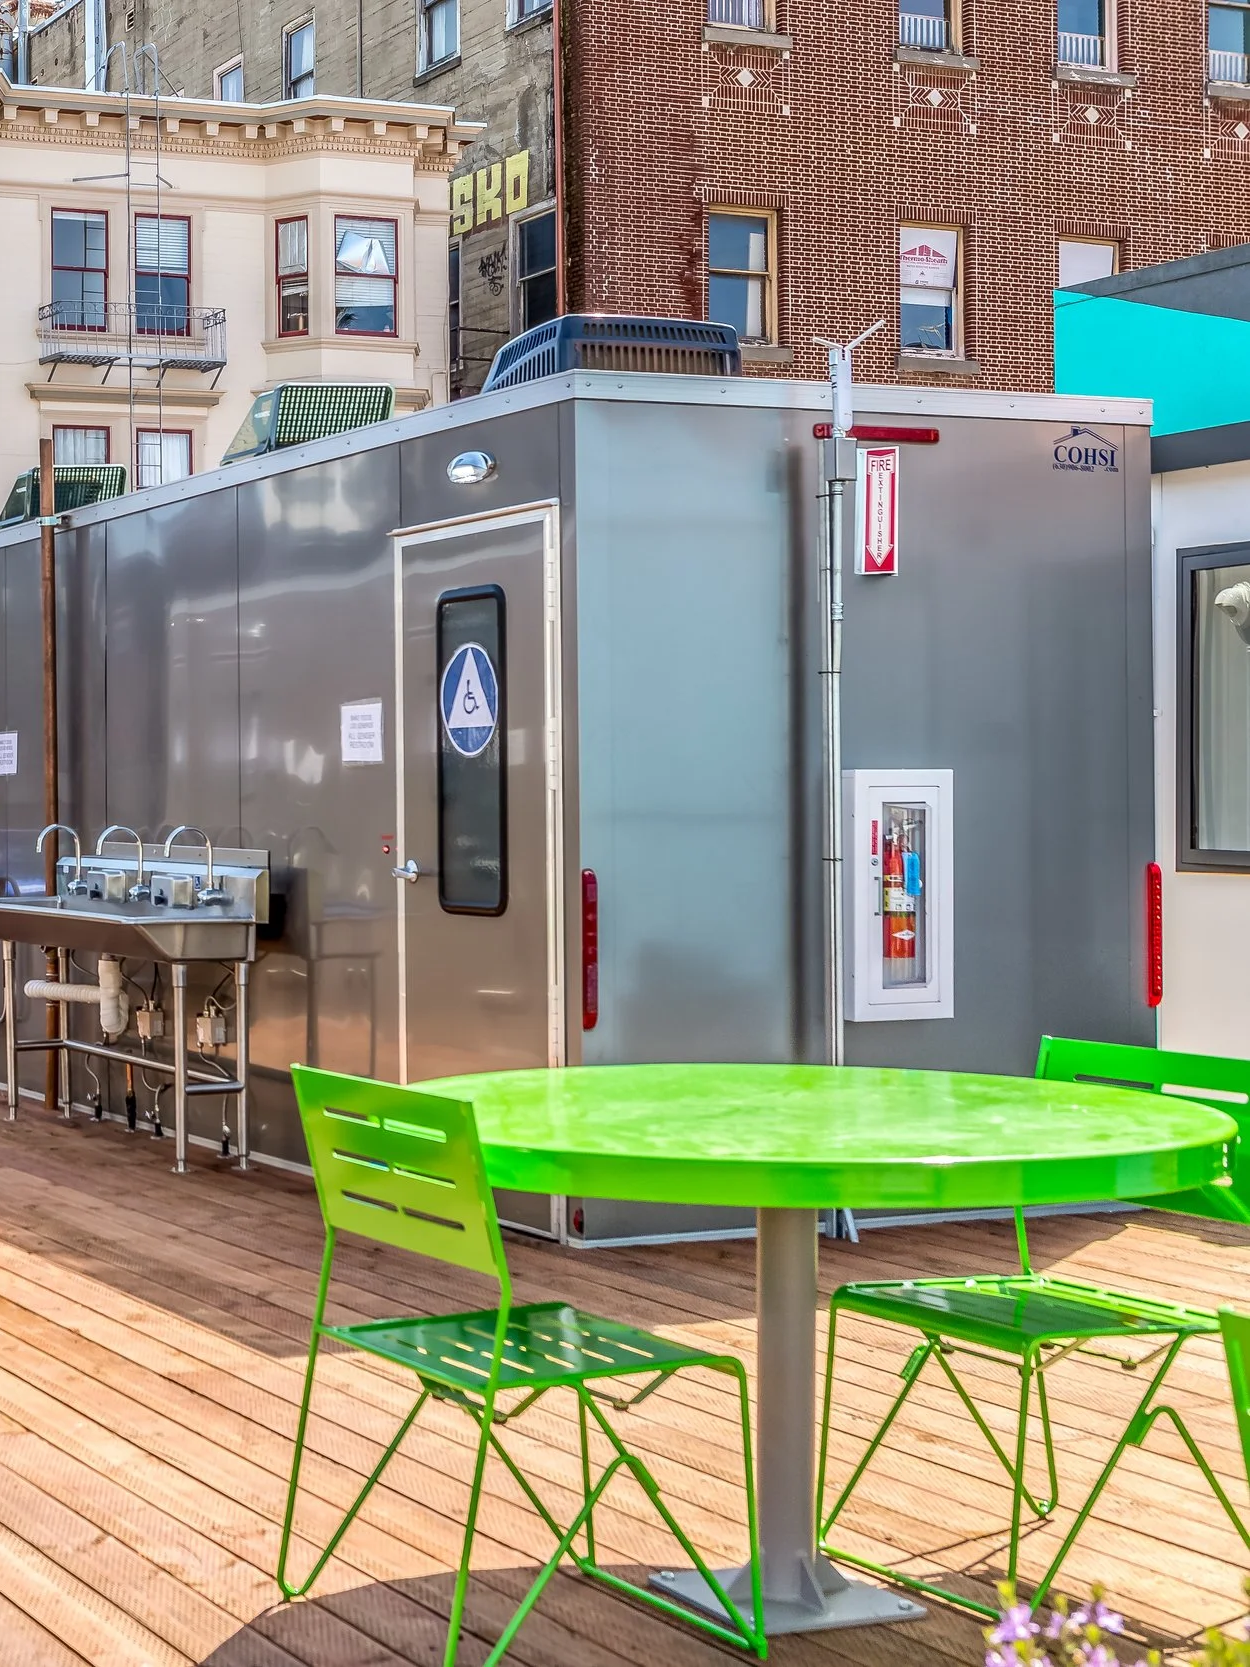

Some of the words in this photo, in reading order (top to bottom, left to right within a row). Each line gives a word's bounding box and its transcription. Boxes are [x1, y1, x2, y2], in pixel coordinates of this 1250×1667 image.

[870, 459, 891, 472] FIRE
[1054, 445, 1116, 467] COHSI
[876, 472, 884, 560] EXTINGUISHER
